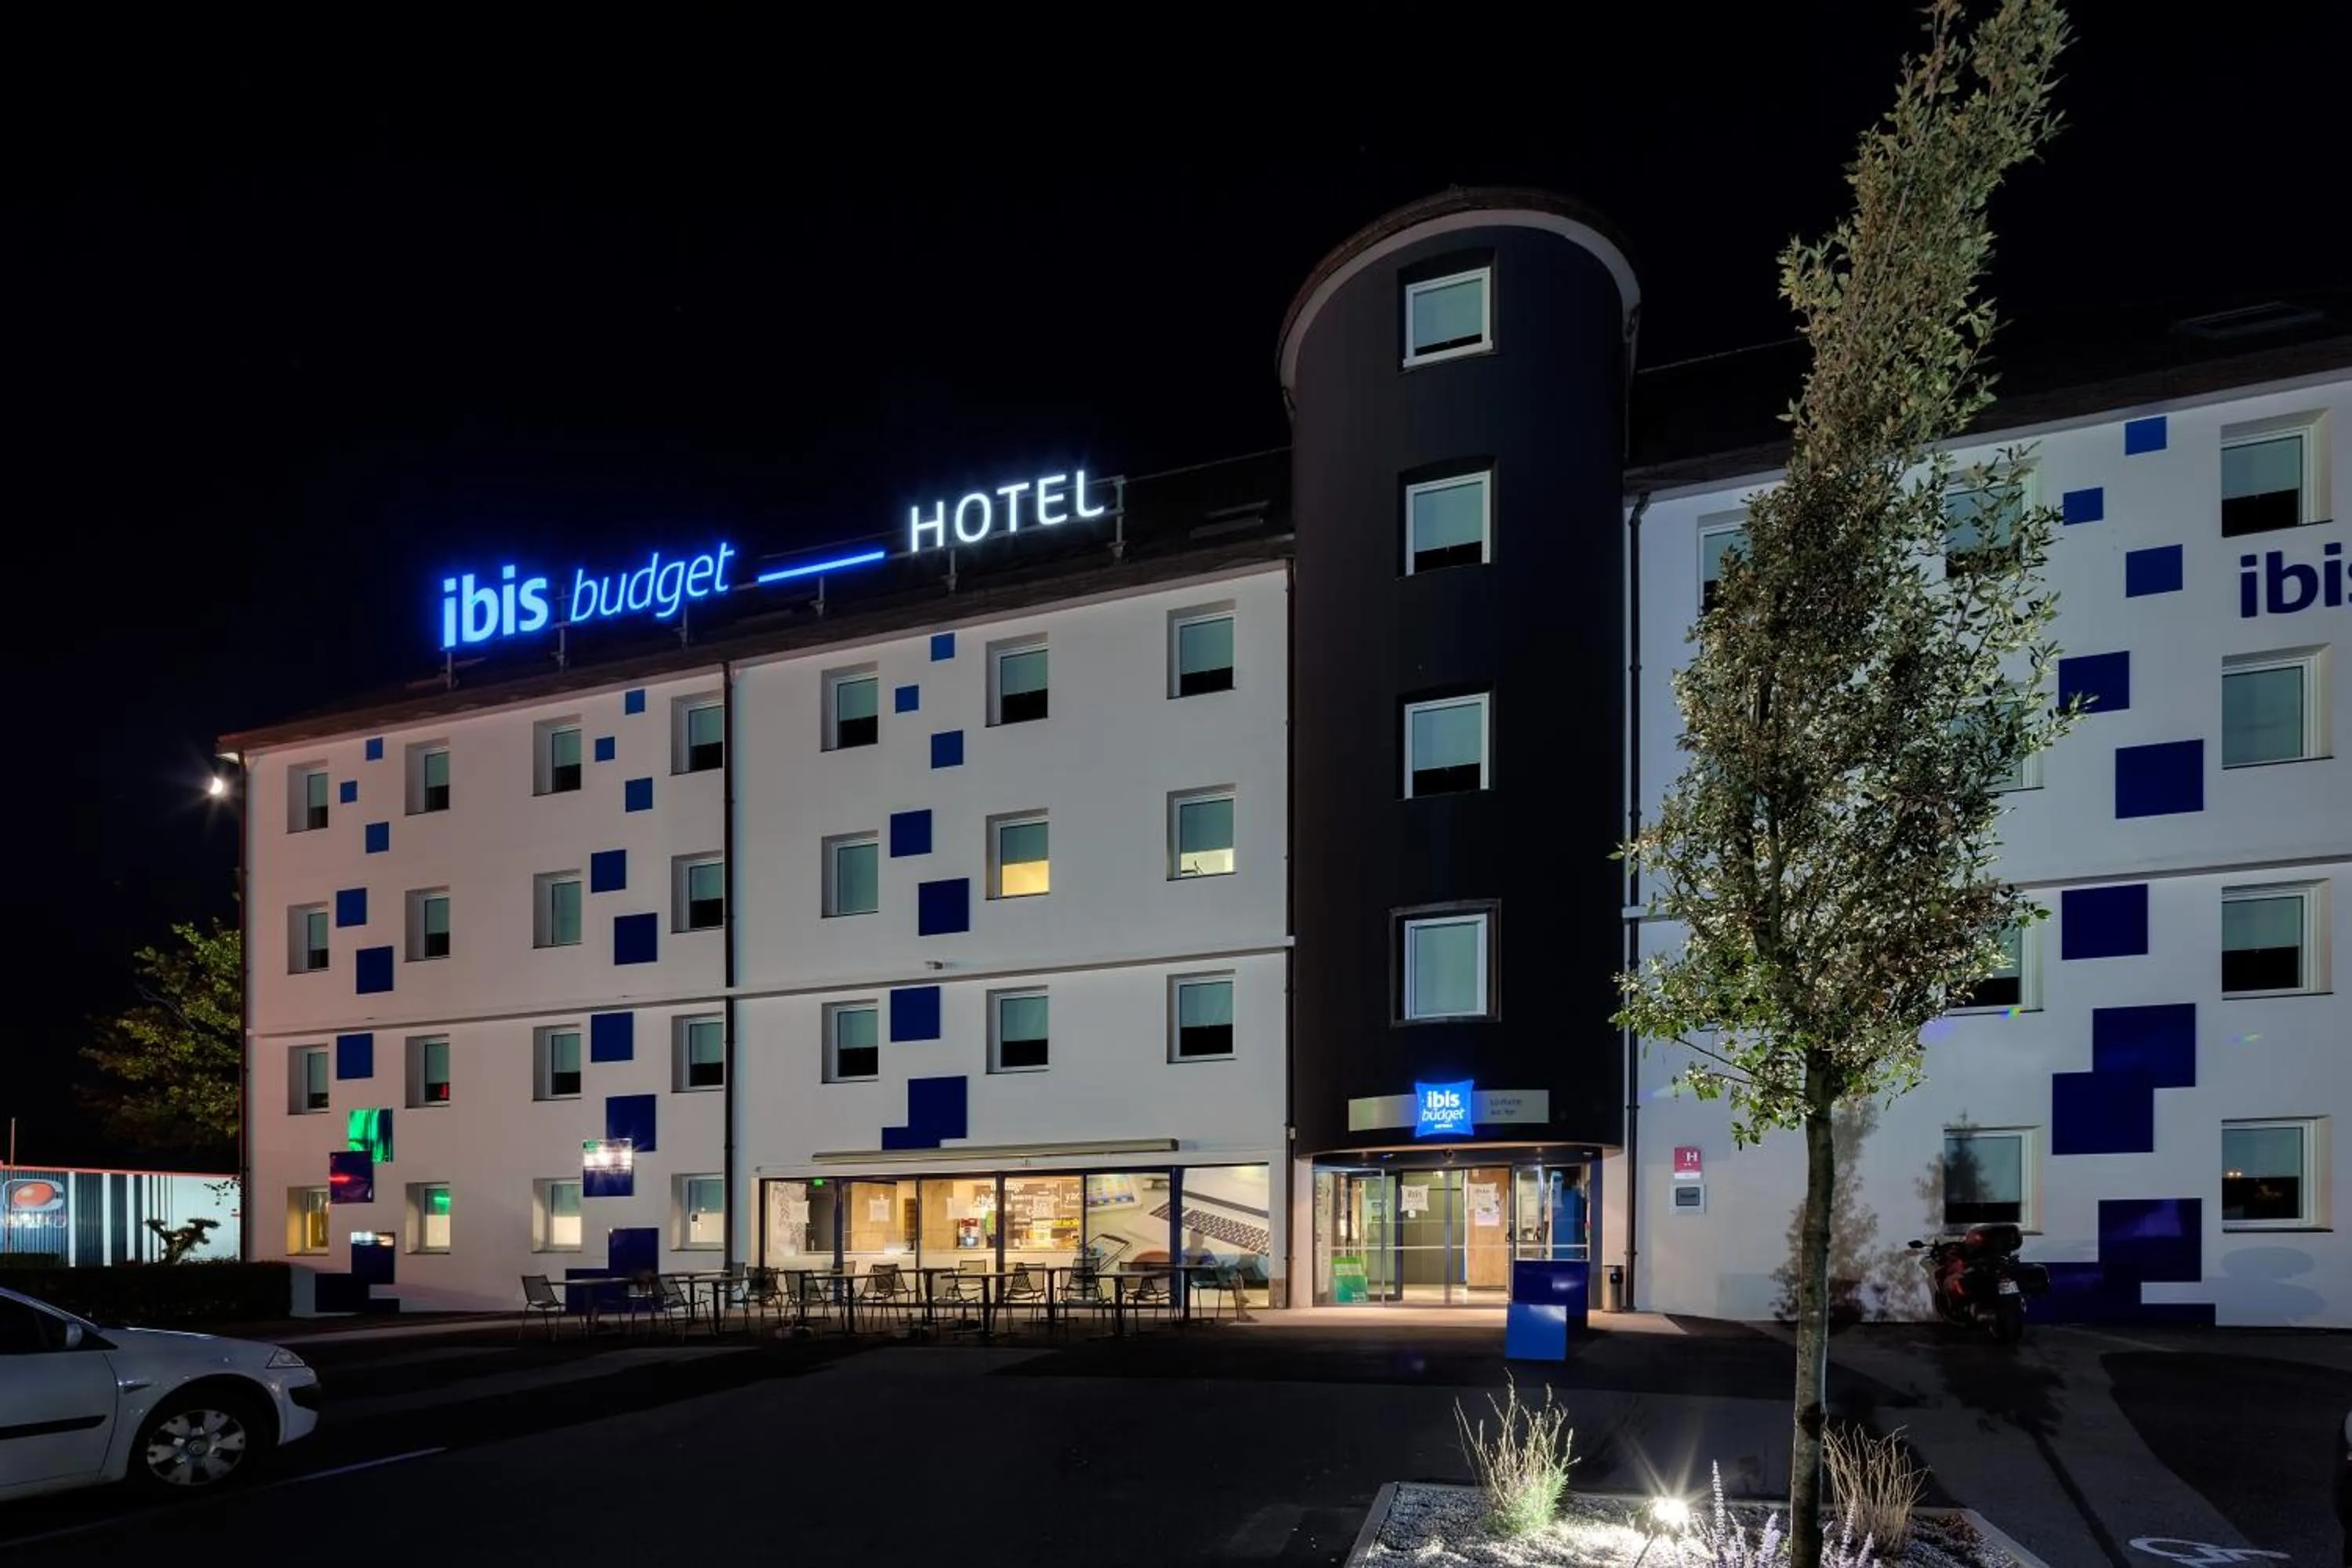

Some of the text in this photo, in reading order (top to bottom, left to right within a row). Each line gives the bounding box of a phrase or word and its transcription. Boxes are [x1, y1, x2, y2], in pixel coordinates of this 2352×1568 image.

[911, 470, 1105, 553] HOTEL
[442, 542, 735, 648] ibis budget
[2240, 542, 2352, 619] ibi
[1421, 1108, 1466, 1124] budget
[1426, 1090, 1461, 1109] ibis
[1686, 1151, 1697, 1162] H
